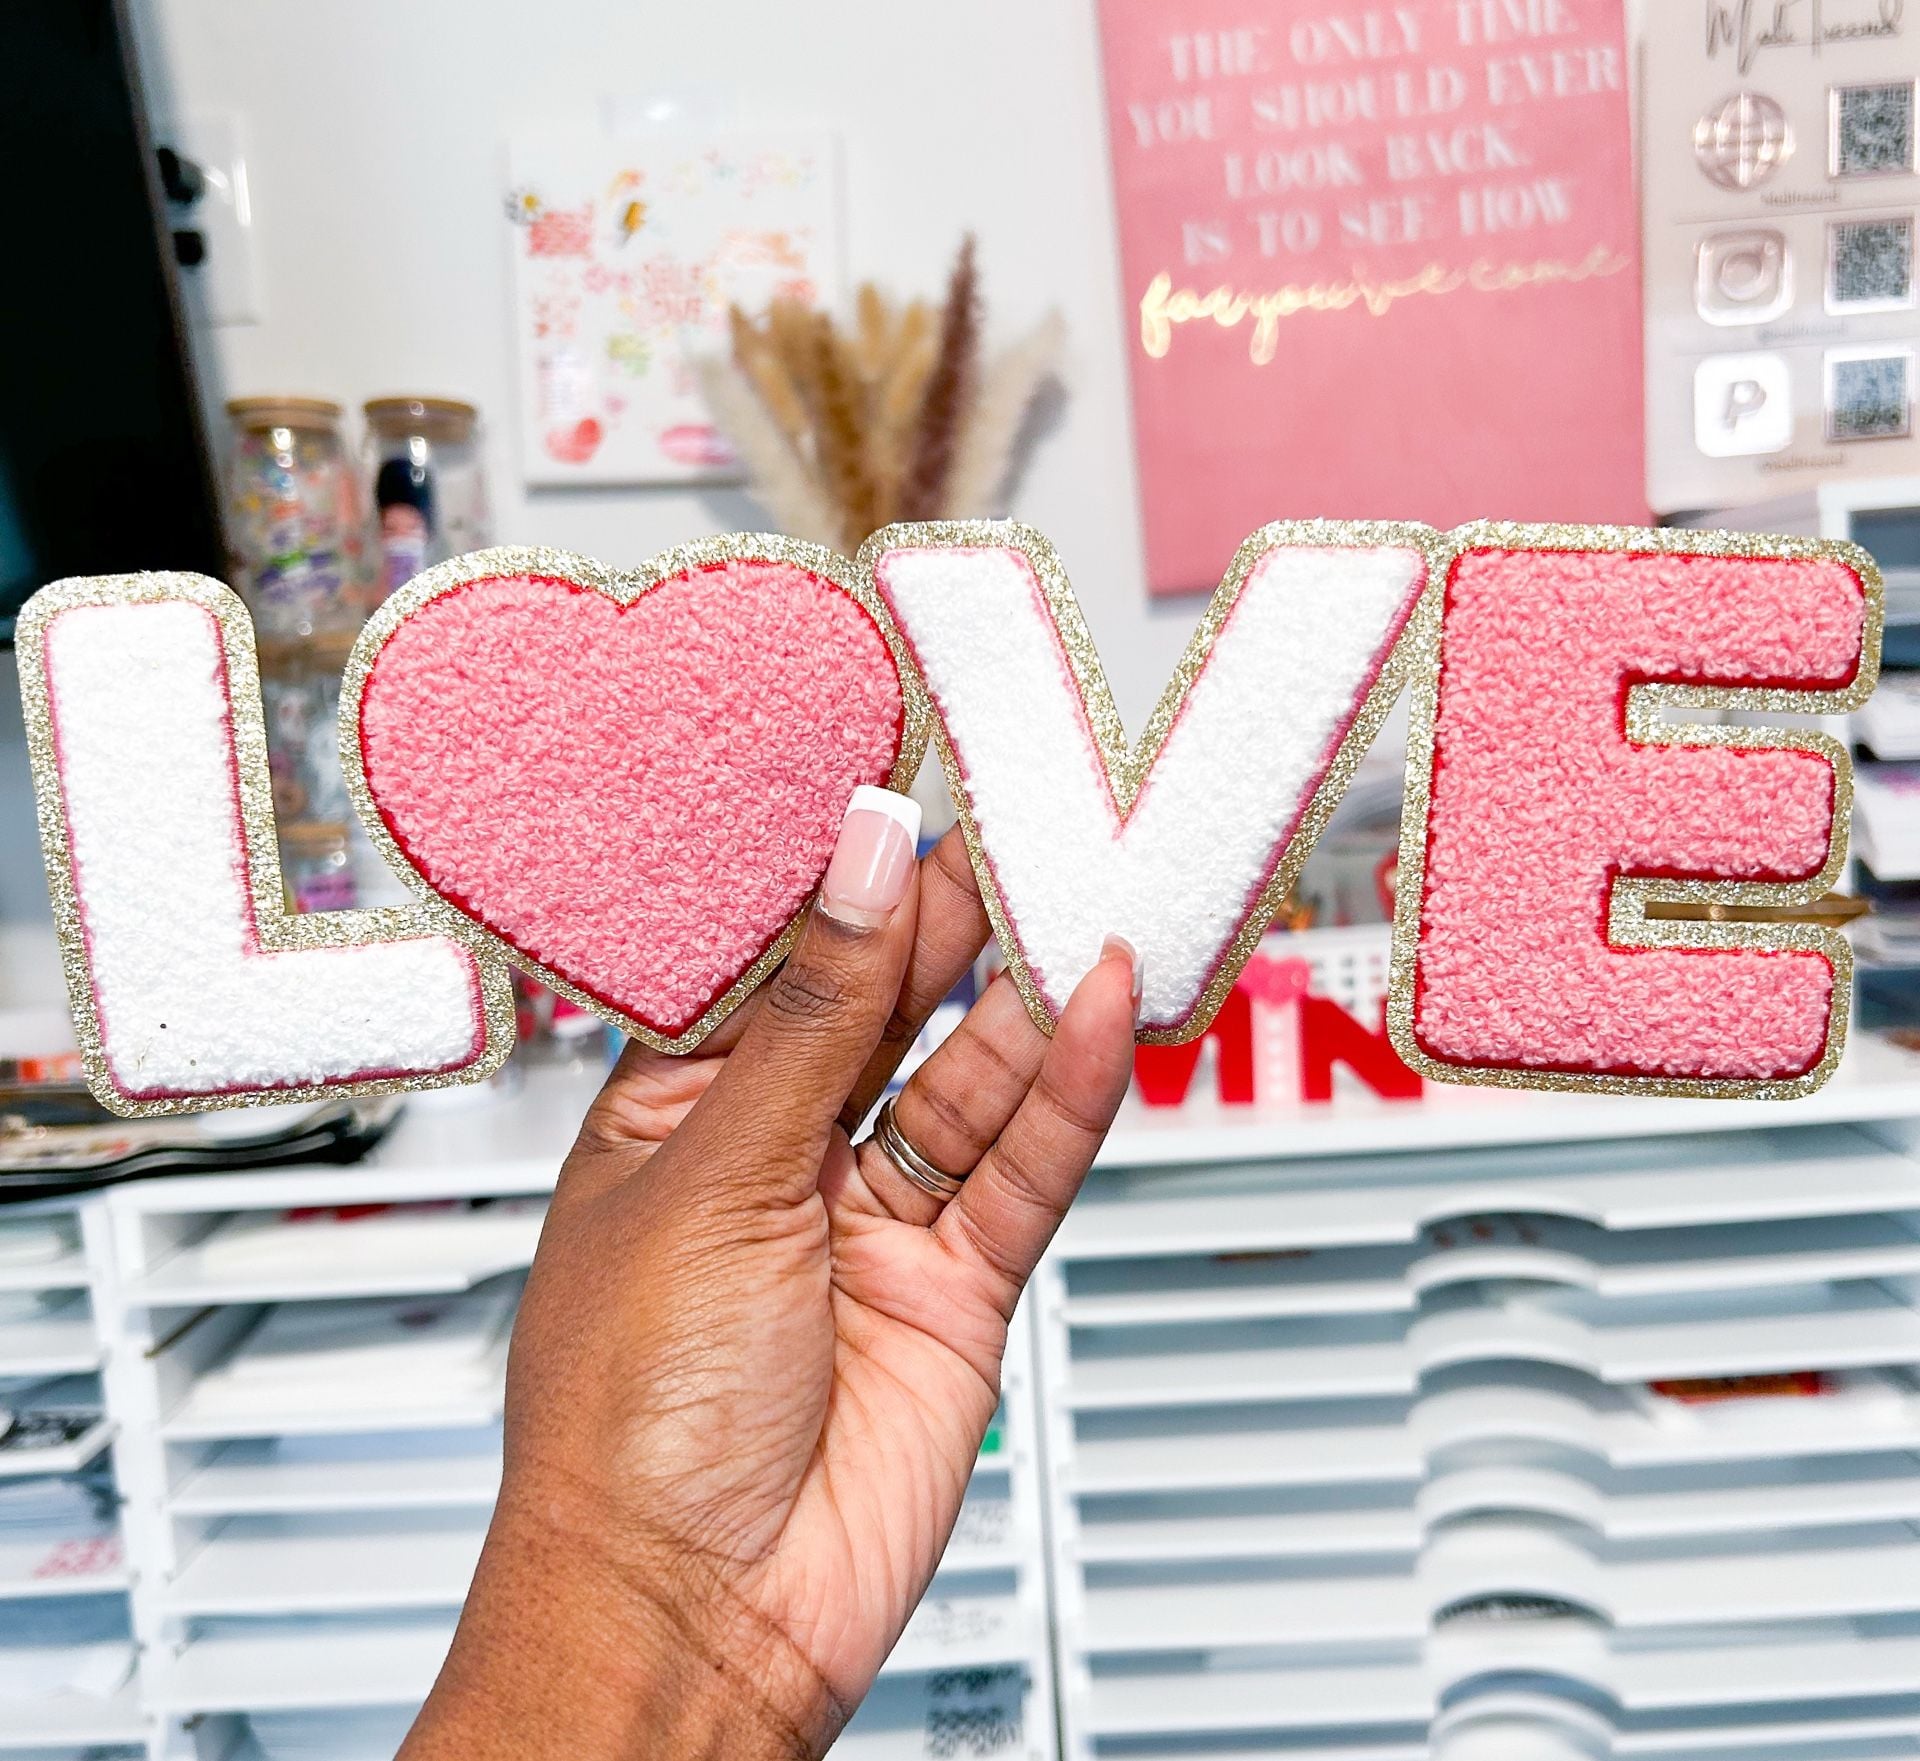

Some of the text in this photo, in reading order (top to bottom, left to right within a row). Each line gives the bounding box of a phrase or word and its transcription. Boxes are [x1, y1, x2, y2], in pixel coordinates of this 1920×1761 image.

[1164, 0, 1579, 84] THE ONLY TIME
[1127, 42, 1621, 150] YOU SHOULD EVER
[1222, 140, 1364, 200] LOOK
[1181, 176, 1578, 266] IS TO SEE HOW
[1139, 268, 1252, 359] far
[1468, 242, 1632, 294] come
